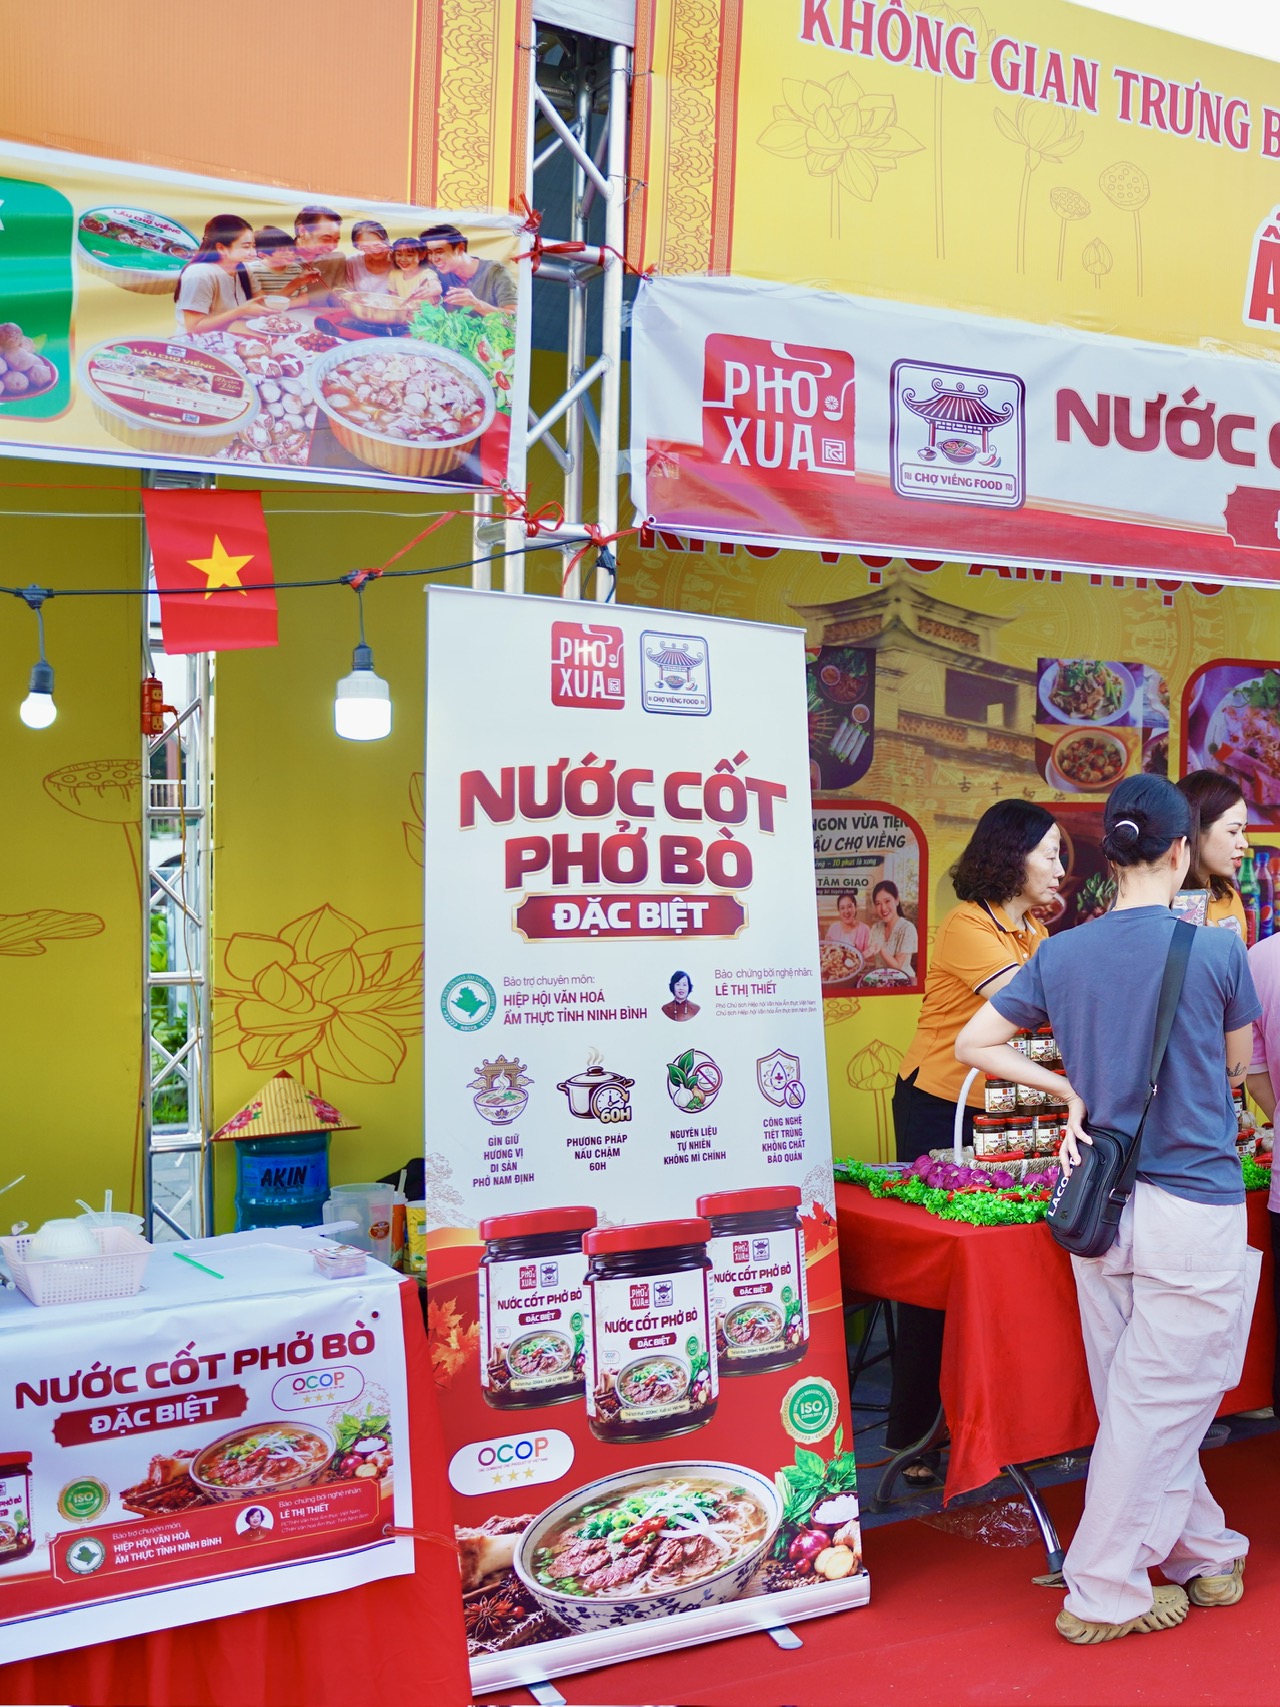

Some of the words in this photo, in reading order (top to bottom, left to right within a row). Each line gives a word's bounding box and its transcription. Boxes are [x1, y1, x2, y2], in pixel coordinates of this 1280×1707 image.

[799, 0, 978, 81] KHÔNG
[989, 38, 1099, 112] GIAN
[1112, 68, 1251, 150] TRƯNG
[1055, 384, 1256, 468] NƯỚC
[915, 473, 939, 485] CHỢ
[975, 479, 1002, 490] FOOD
[459, 752, 655, 829] NƯỚC
[663, 750, 787, 834] CỐT
[852, 813, 878, 829] VỪA
[835, 835, 863, 852] CHỢ
[867, 830, 906, 848] VIỀNG
[505, 820, 649, 890] PHỞ
[659, 826, 753, 889] BÒ
[818, 877, 839, 886] TÂM
[553, 897, 631, 935] ĐẶC
[639, 897, 709, 935] BIỆT
[715, 969, 732, 979] Bảo
[736, 968, 762, 979] chứng
[764, 968, 775, 977] bởi
[776, 970, 793, 979] nghệ
[504, 977, 522, 986] Bảo
[523, 976, 535, 988] trợ
[537, 975, 569, 987] chuyên
[572, 975, 595, 984] môn:
[715, 983, 728, 995] LÊ
[731, 984, 748, 997] THỊ
[751, 980, 777, 994] THIẾT
[504, 991, 529, 1008] HIỆP
[532, 991, 550, 1006] HỘI
[554, 990, 577, 1004] VĂN
[580, 989, 605, 1003] HOÁ
[504, 1010, 521, 1025] ẨM
[525, 1011, 554, 1026] THỰC
[557, 1007, 584, 1022] TỈNH
[587, 1009, 616, 1020] NINH
[620, 1006, 647, 1019] BÌNH
[600, 1106, 632, 1123] 60H
[763, 1117, 783, 1127] CÔNG
[785, 1114, 802, 1126] NGHỆ
[488, 1135, 503, 1146] GÌN
[505, 1133, 519, 1144] GIỮ
[670, 1127, 699, 1139] NGUYÊN
[701, 1125, 717, 1137] LIỆU
[764, 1130, 779, 1140] TIỆT
[781, 1127, 803, 1137] TRÙNG
[567, 1136, 602, 1147] PHƯƠNG
[605, 1133, 628, 1143] PHÁP
[678, 1141, 687, 1151] TỰ
[689, 1140, 711, 1149] NHIÊN
[762, 1140, 787, 1152] KHÔNG
[789, 1138, 805, 1149] CHẤT
[484, 1149, 513, 1160] HƯƠNG
[515, 1148, 523, 1159] VỊ
[575, 1147, 592, 1159] NẤU
[595, 1148, 620, 1159] CHẬM
[664, 1153, 689, 1165] KHÔNG
[691, 1151, 700, 1162] MÌ
[703, 1150, 726, 1160] CHÍNH
[768, 1153, 782, 1163] BẢO
[785, 1151, 802, 1161] QUẢN
[491, 1164, 499, 1172] DI
[502, 1161, 517, 1172] SẢN
[590, 1162, 606, 1171] 60H
[260, 1165, 307, 1187] AKIN
[473, 1175, 491, 1187] PHỞ
[493, 1176, 512, 1185] NAM
[514, 1173, 534, 1185] ĐỊNH
[605, 1317, 633, 1333] NƯỚC
[636, 1312, 659, 1330] CỐT
[662, 1310, 684, 1328] PHỞ
[686, 1307, 698, 1321] BÒ
[15, 1361, 138, 1409] NƯỚC
[145, 1340, 226, 1389] CỐT
[233, 1331, 314, 1375] PHỞ
[321, 1320, 375, 1359] BÒ
[293, 1372, 344, 1391] OCOP
[90, 1408, 151, 1434] ĐẶC
[156, 1395, 218, 1423] BIỆT
[801, 1400, 822, 1414] ISO
[478, 1437, 549, 1466] OCOP
[73, 1491, 94, 1504] ISO
